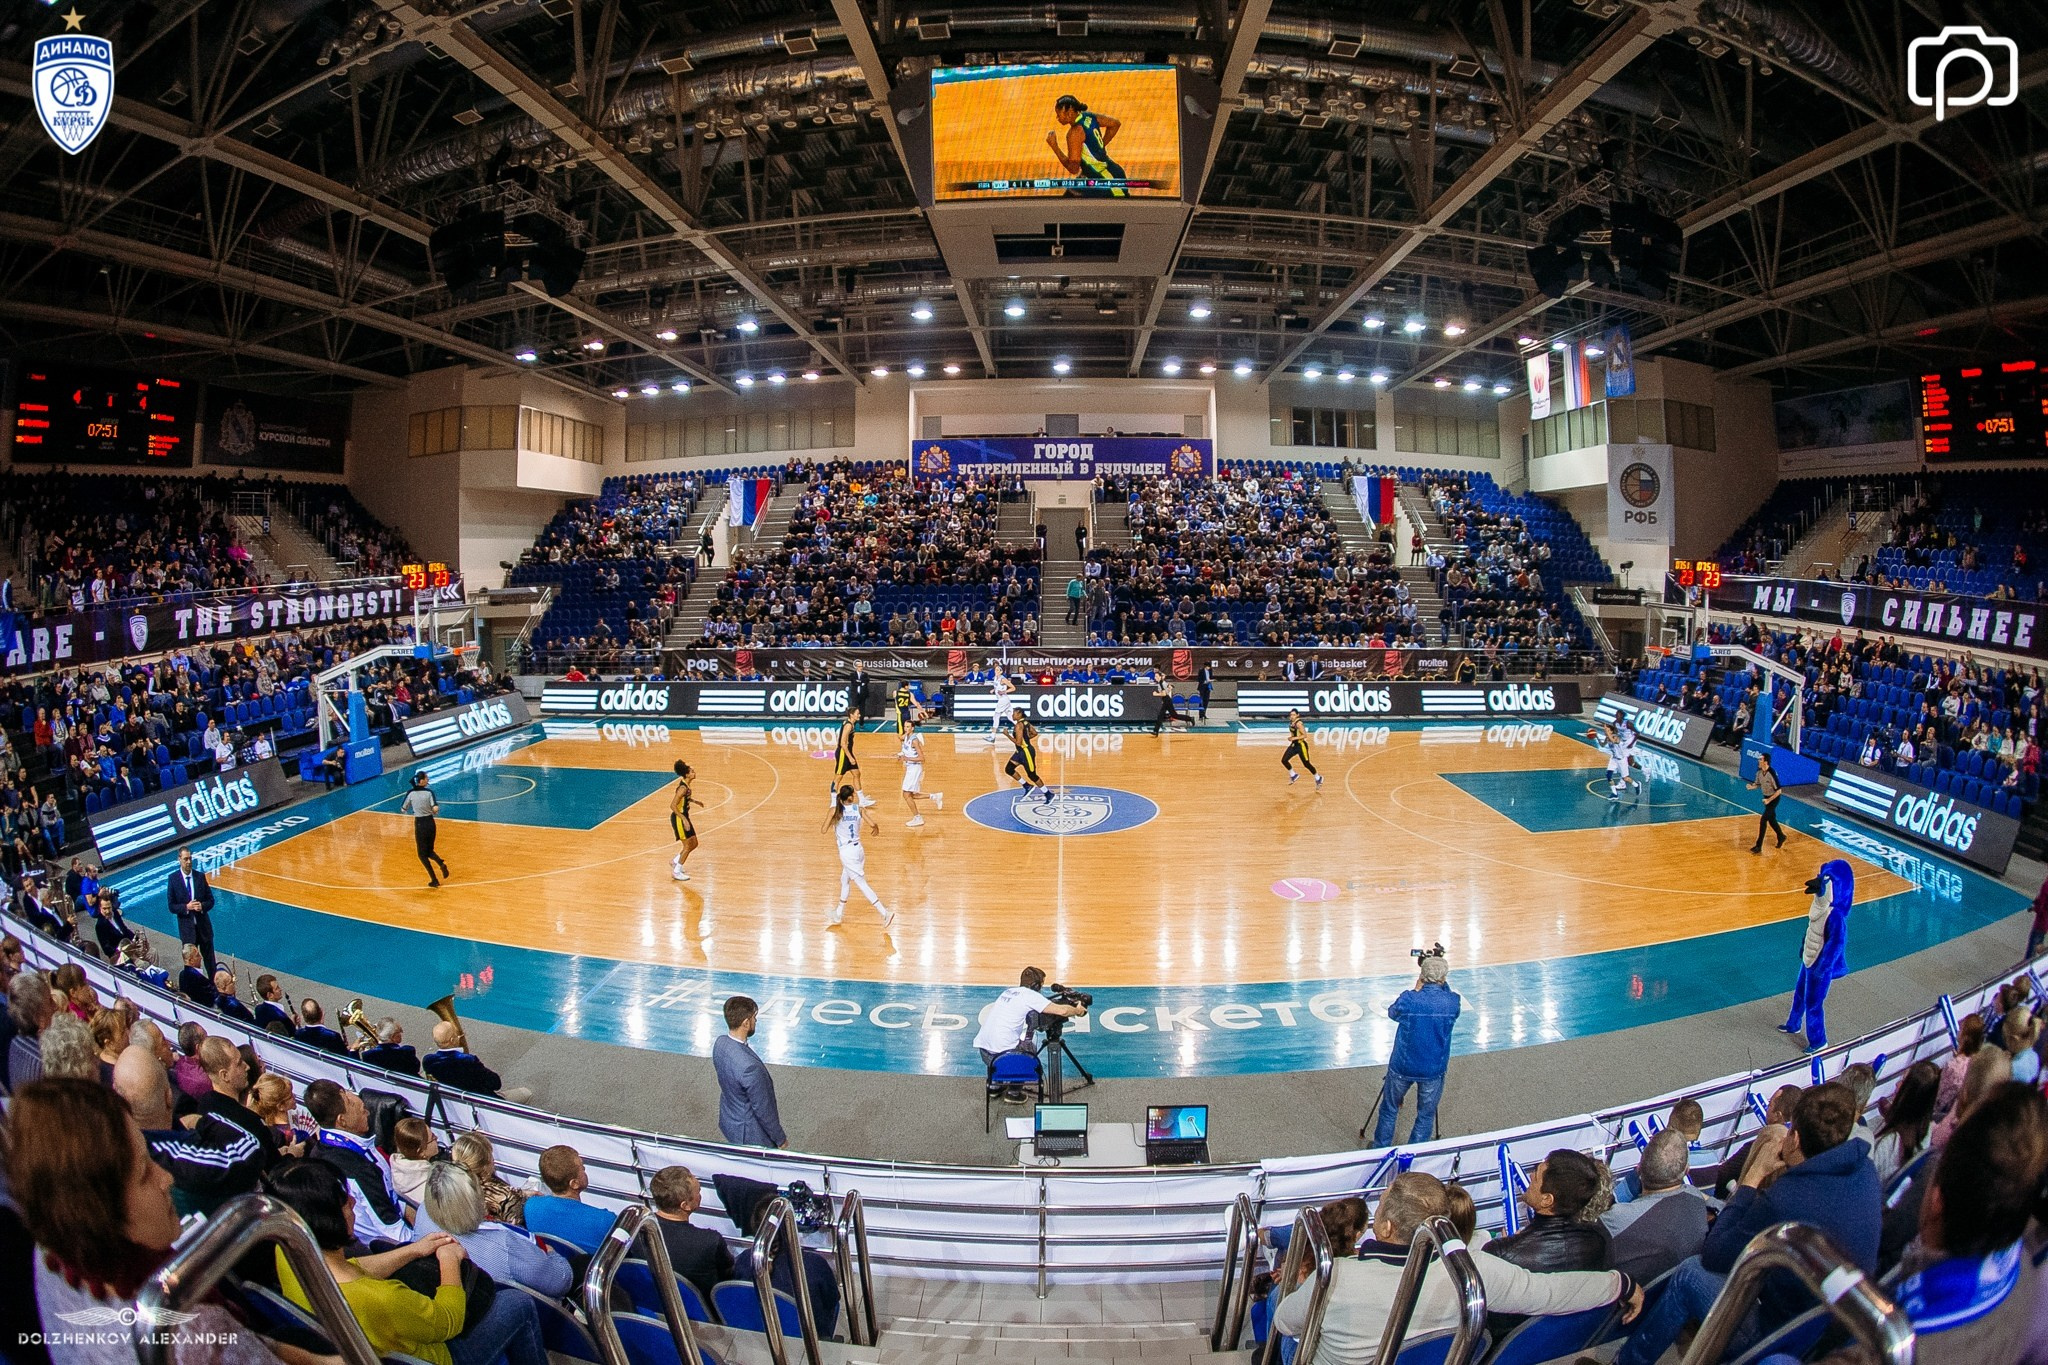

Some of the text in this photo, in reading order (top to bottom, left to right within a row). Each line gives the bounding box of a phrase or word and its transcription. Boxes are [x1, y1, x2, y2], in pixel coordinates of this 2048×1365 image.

[88, 423, 118, 438] 07:51
[1033, 443, 1094, 461] ГОРОД
[958, 460, 1166, 477] УСТРЕМЛЕННЫЙ В БУДУЩЕЕ!
[1624, 510, 1658, 525] РФБ
[409, 572, 426, 588] 23
[434, 571, 448, 586] 23
[1681, 570, 1694, 585] 23
[1704, 571, 1720, 586] 23
[175, 605, 233, 640] THE
[250, 589, 402, 629] STRONGEST!
[1753, 584, 1796, 614] МЫ
[1882, 596, 2036, 649] СИЛЬНЕЕ
[686, 658, 719, 672] РФБ
[1023, 657, 1100, 666] ЧЕМПИОНАТ
[1101, 657, 1153, 666] РОССИИ
[1418, 659, 1449, 668] molten
[600, 682, 669, 711] adidas
[770, 683, 849, 712] adidas
[898, 698, 909, 707] 24
[1037, 687, 1124, 718] adidas
[1314, 683, 1392, 713] adidas
[1489, 683, 1555, 712] adidas
[458, 700, 513, 737] adidas
[1635, 706, 1687, 745] adidas
[175, 776, 260, 830] adidas
[1894, 789, 1977, 853] adidas
